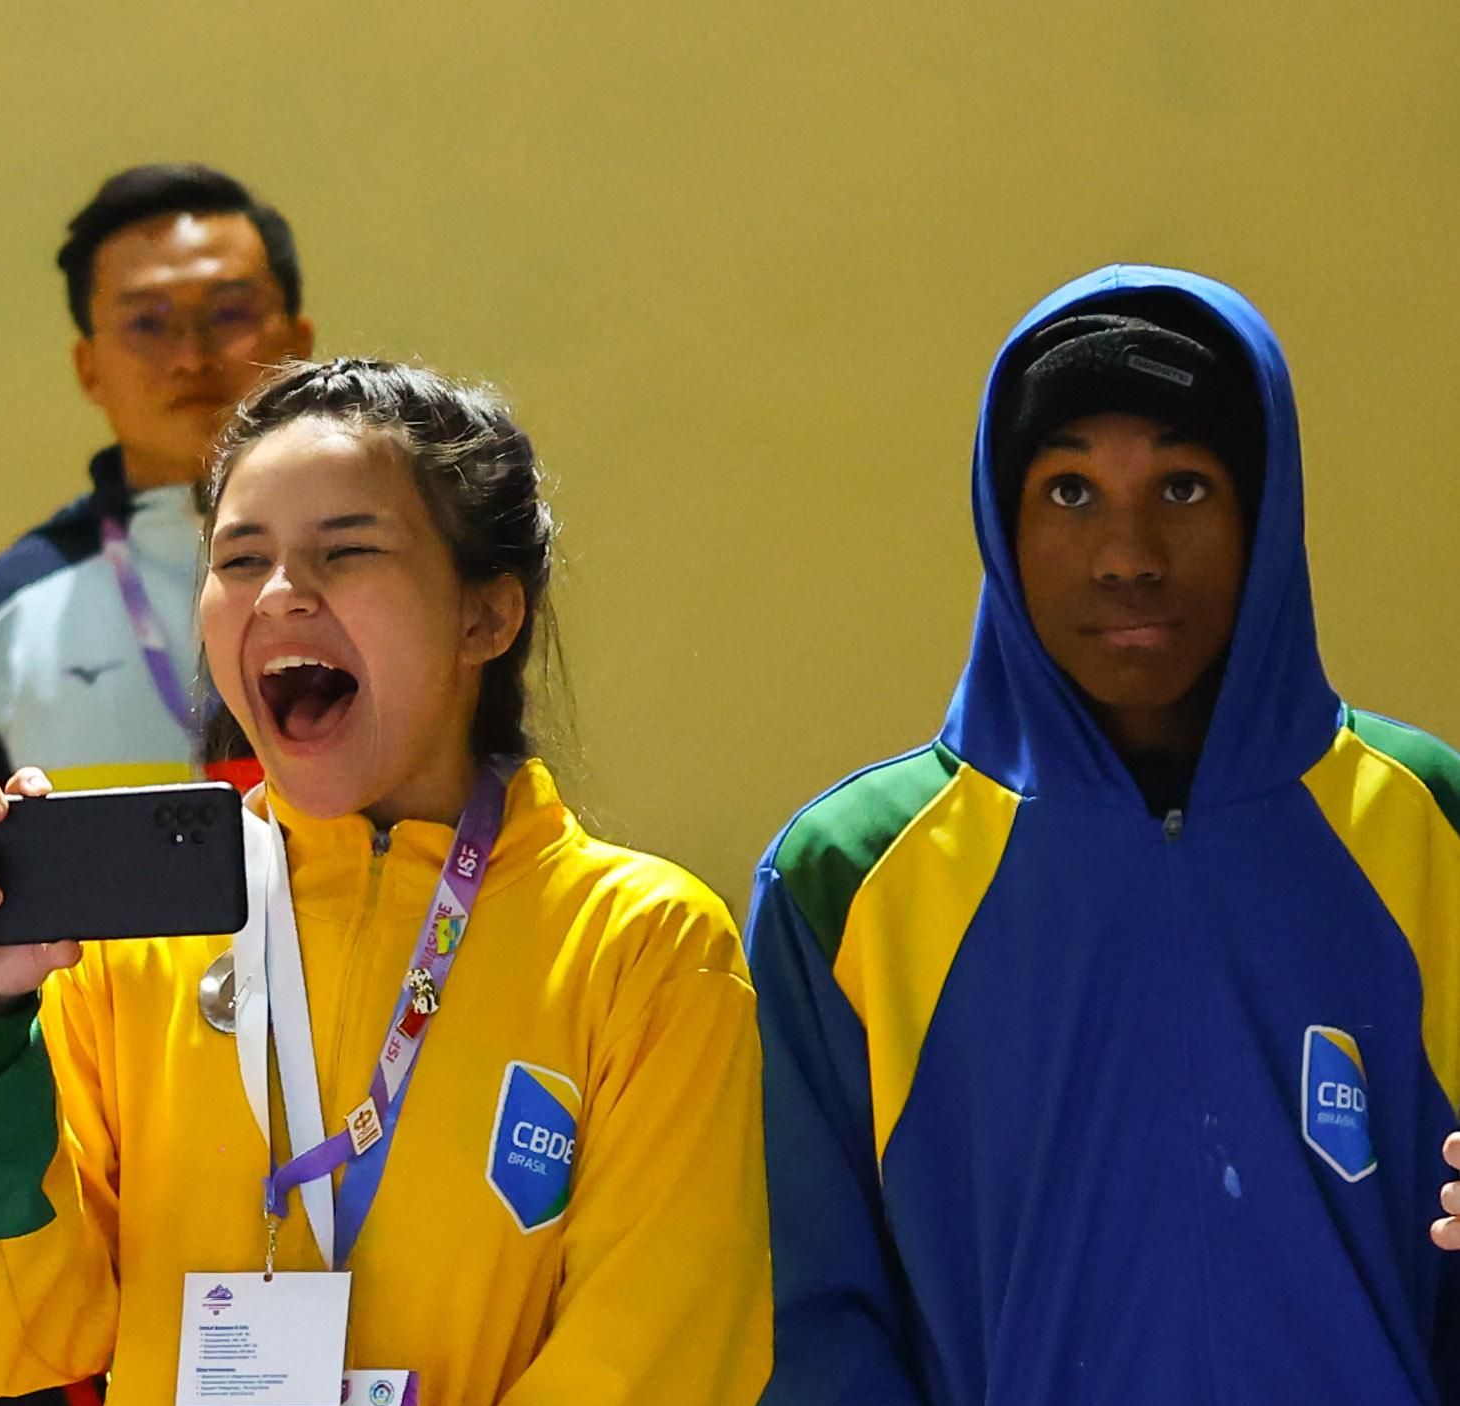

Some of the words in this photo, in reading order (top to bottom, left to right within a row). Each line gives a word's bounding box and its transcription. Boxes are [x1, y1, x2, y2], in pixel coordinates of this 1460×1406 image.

[456, 844, 479, 878] ISF
[385, 1036, 401, 1064] ISF
[1317, 1081, 1367, 1113] CBD
[507, 1151, 548, 1176] BRASIL
